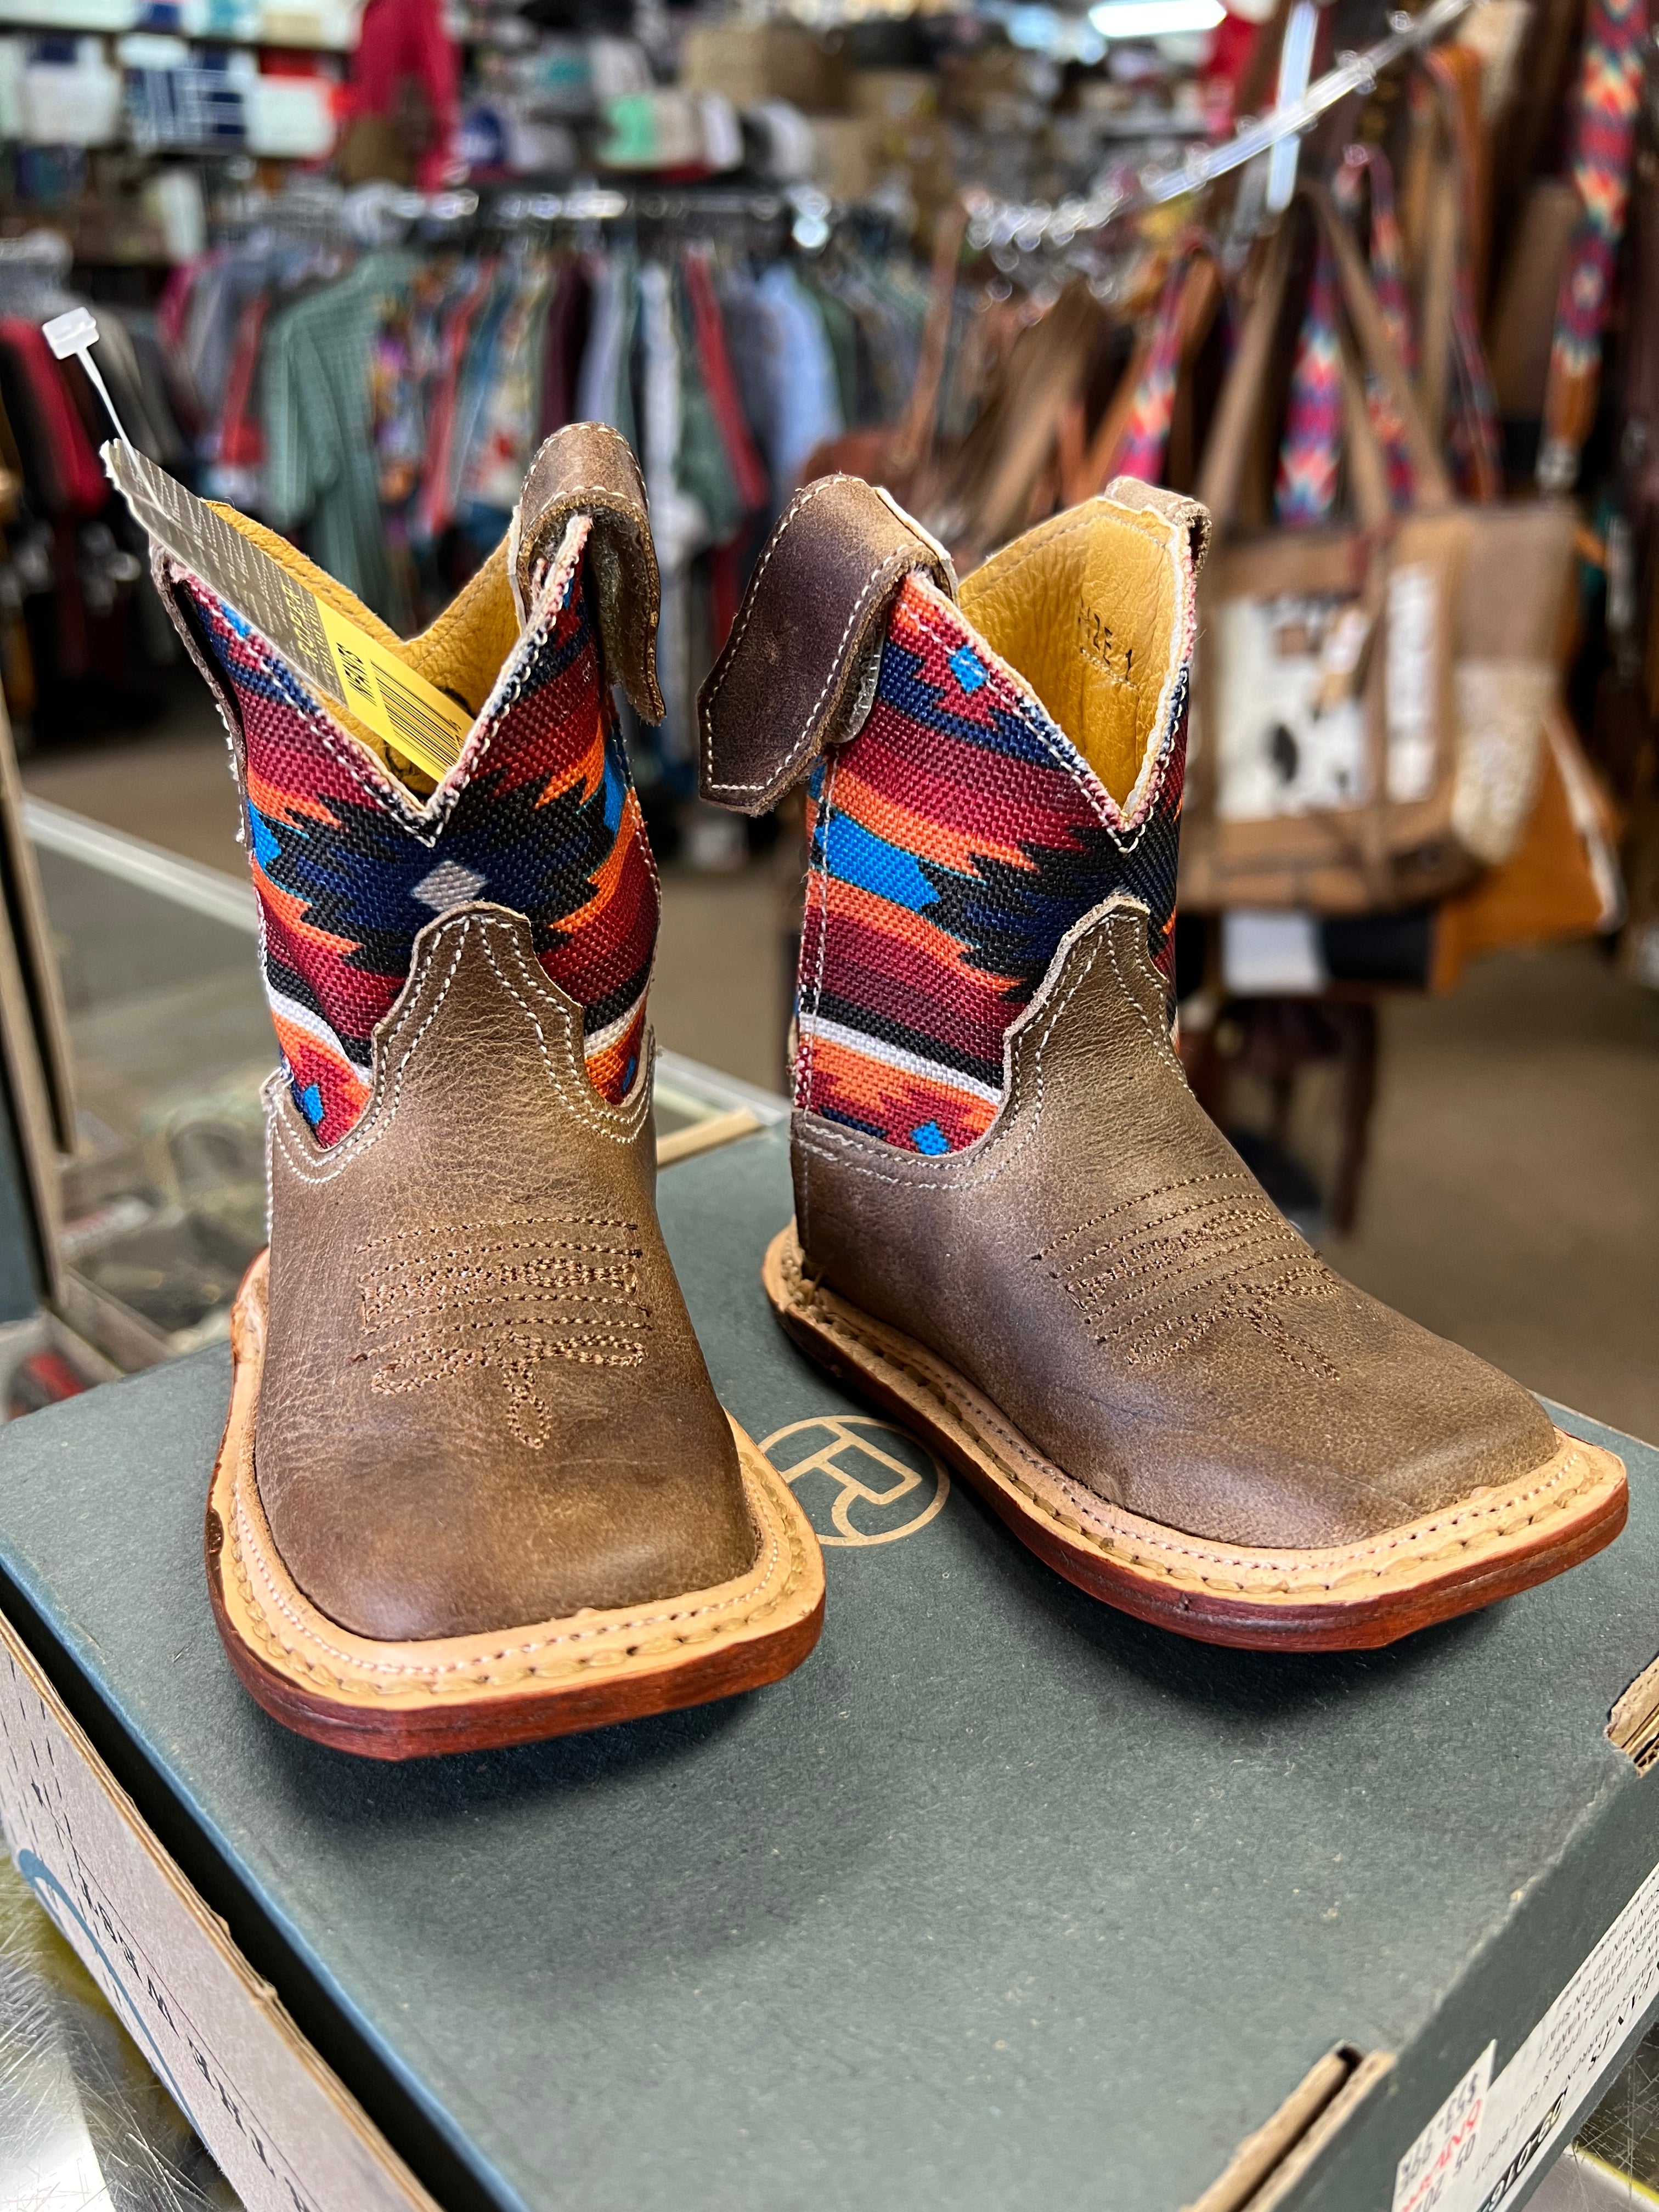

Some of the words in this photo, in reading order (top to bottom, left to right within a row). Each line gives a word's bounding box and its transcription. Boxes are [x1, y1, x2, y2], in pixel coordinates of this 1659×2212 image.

[281, 584, 318, 664] ROPER
[336, 642, 377, 707] INFANTS
[78, 1870, 180, 2039] WEST
[1584, 1945, 1628, 2012] LEATHER
[1594, 1916, 1636, 1981] PRINTED
[1573, 1979, 1591, 2010] ON
[1591, 1953, 1633, 2019] LEATHER
[1537, 2004, 1572, 2061] SHAFT
[1549, 2012, 1580, 2061] VAMP
[1554, 2017, 1588, 2071] UPPER
[188, 2035, 276, 2179] THE
[1511, 2084, 1541, 2131] SOLE
[1474, 2128, 1509, 2184] BOOT
